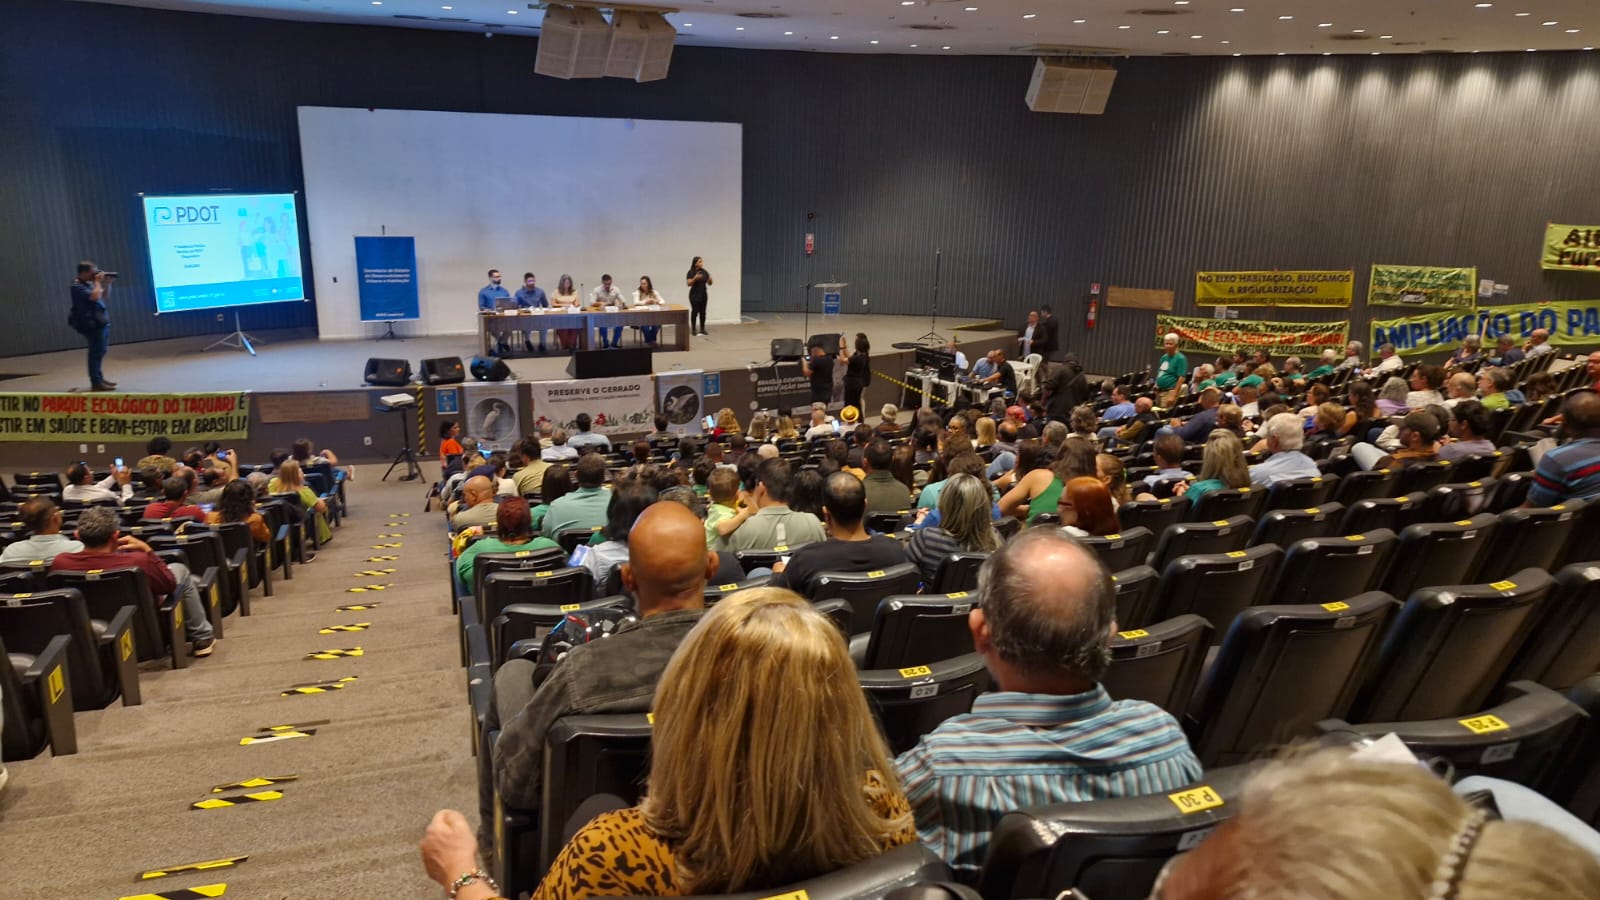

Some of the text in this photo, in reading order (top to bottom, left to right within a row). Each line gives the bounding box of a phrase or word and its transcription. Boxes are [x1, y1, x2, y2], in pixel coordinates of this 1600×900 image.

[176, 205, 219, 222] PDOT
[1520, 310, 1557, 337] DO
[548, 388, 590, 396] PRESERVE
[601, 384, 640, 393] CERRADO
[23, 396, 40, 412] NO
[42, 396, 87, 413] PARQUE
[91, 394, 159, 414] ECOLÓGICO
[163, 398, 180, 414] DO
[26, 418, 45, 433] EM
[49, 414, 86, 433] SAÚDE
[90, 419, 97, 433] E
[100, 418, 168, 435] BEM-ESTAR
[172, 419, 190, 434] EM
[1178, 789, 1215, 808] P 30
